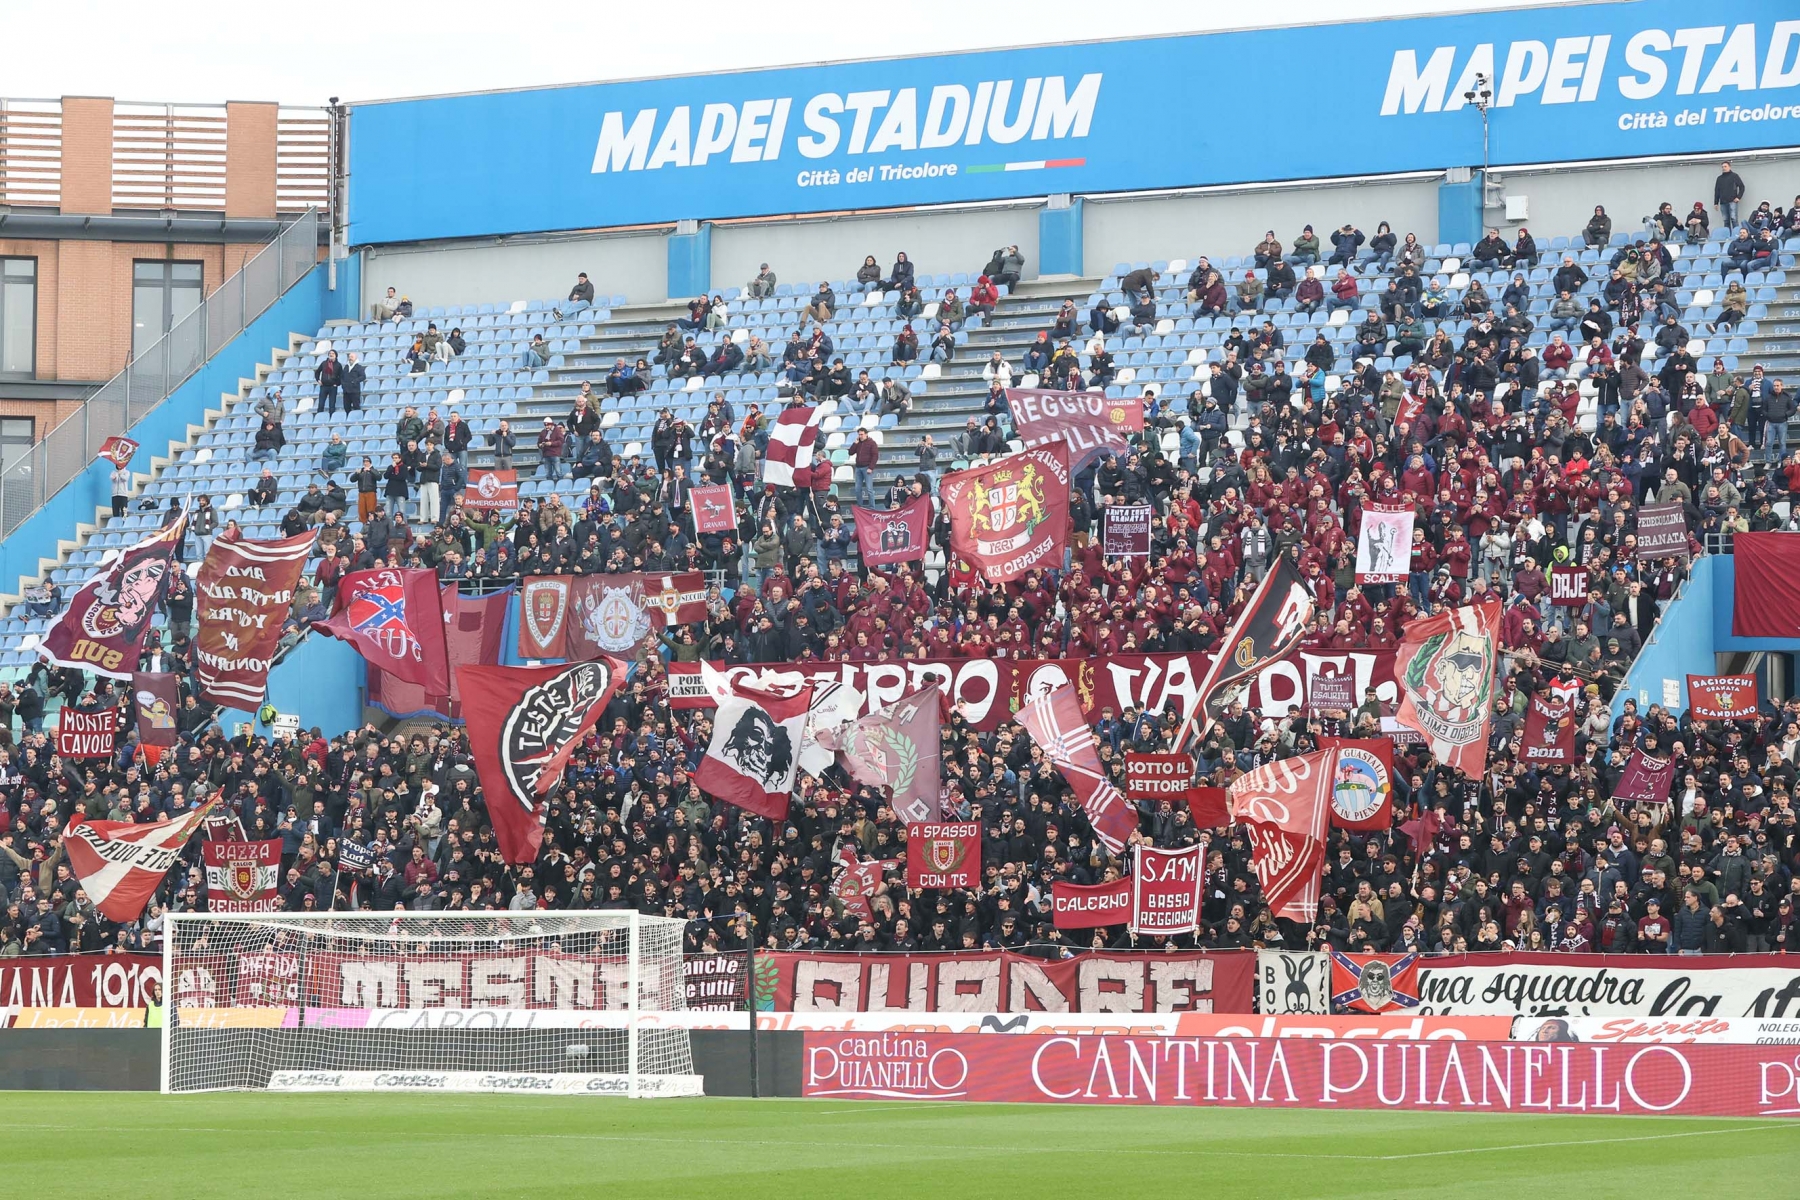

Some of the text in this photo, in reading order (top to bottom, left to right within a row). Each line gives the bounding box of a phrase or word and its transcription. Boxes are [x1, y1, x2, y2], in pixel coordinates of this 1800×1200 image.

[1380, 34, 1611, 116] MAPEI
[591, 73, 1103, 174] MAPEI STADIUM
[1618, 103, 1800, 130] Città del Tricolore
[797, 160, 959, 188] Città del Tricolore
[1011, 394, 1103, 426] REGGIO
[465, 498, 516, 507] IMMERGASATI
[1373, 503, 1406, 513] SULLE
[704, 521, 727, 529] GRANATA
[1637, 513, 1685, 528] PEDECOLLINA
[1638, 532, 1687, 547] GRANATA
[1364, 574, 1399, 584] SCALE
[1552, 573, 1587, 599] DAJE
[1313, 691, 1349, 700] ESAURITI
[1319, 684, 1343, 692] TUTTI
[1695, 706, 1756, 718] SCANDIANO
[64, 711, 112, 731] MONTE
[61, 734, 112, 754] CAVOLO
[1527, 747, 1565, 759] BOIA
[1128, 761, 1189, 774] SOTTO IL
[1344, 749, 1387, 782] GUASTALLA
[1129, 780, 1189, 792] SETTORE
[1340, 808, 1350, 819] IN
[1354, 803, 1381, 820] PIENA
[910, 825, 977, 838] A SPASSO
[216, 843, 269, 860] RAZZA
[342, 837, 376, 857] Proper
[208, 871, 218, 885] 19
[919, 873, 969, 887] CON TE
[1056, 892, 1129, 912] CALERNO
[1148, 893, 1190, 908] BASSA
[1140, 909, 1194, 926] REGGIANA
[240, 956, 313, 977] DIFFIDAI
[1482, 968, 1646, 1011] squadra
[1591, 1019, 1730, 1044] Spirito
[839, 1033, 928, 1057] cantina
[808, 1046, 968, 1090] PUIANELLO
[1031, 1038, 1299, 1103] CANTINA
[1320, 1041, 1692, 1111] PUIANELLO
